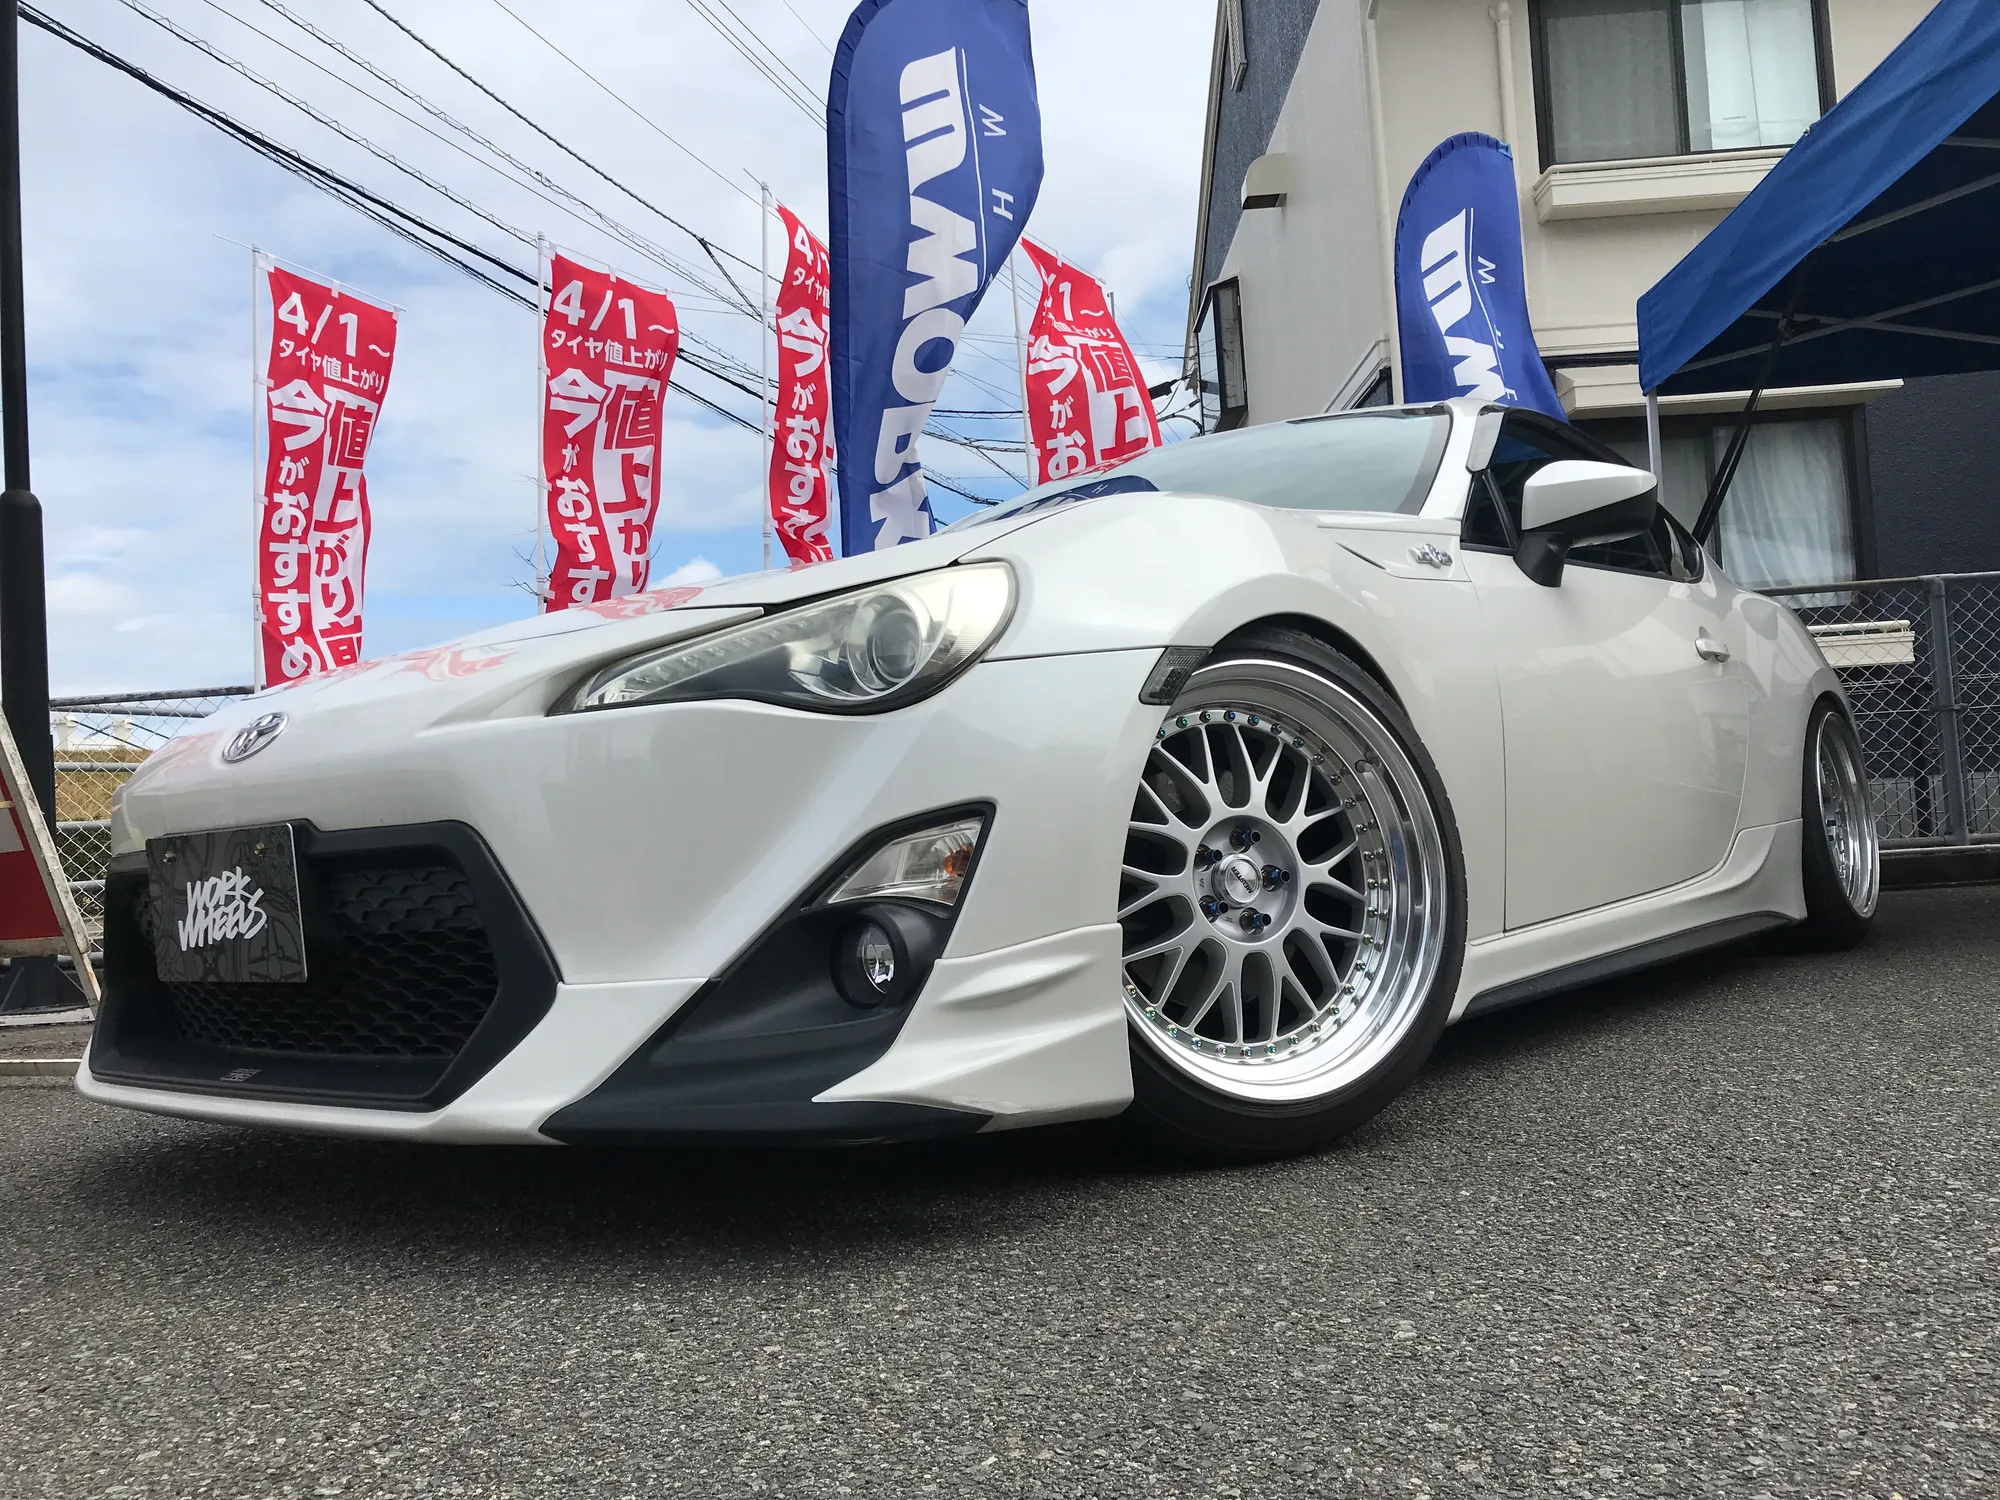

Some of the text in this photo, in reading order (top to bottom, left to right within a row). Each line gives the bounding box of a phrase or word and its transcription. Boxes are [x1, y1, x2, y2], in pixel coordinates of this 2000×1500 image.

[279, 340, 386, 395] タイヤ値上がり
[551, 330, 669, 373] タイヤ値上がり
[268, 378, 329, 679] 今がおすすめ
[186, 866, 253, 910] WORK
